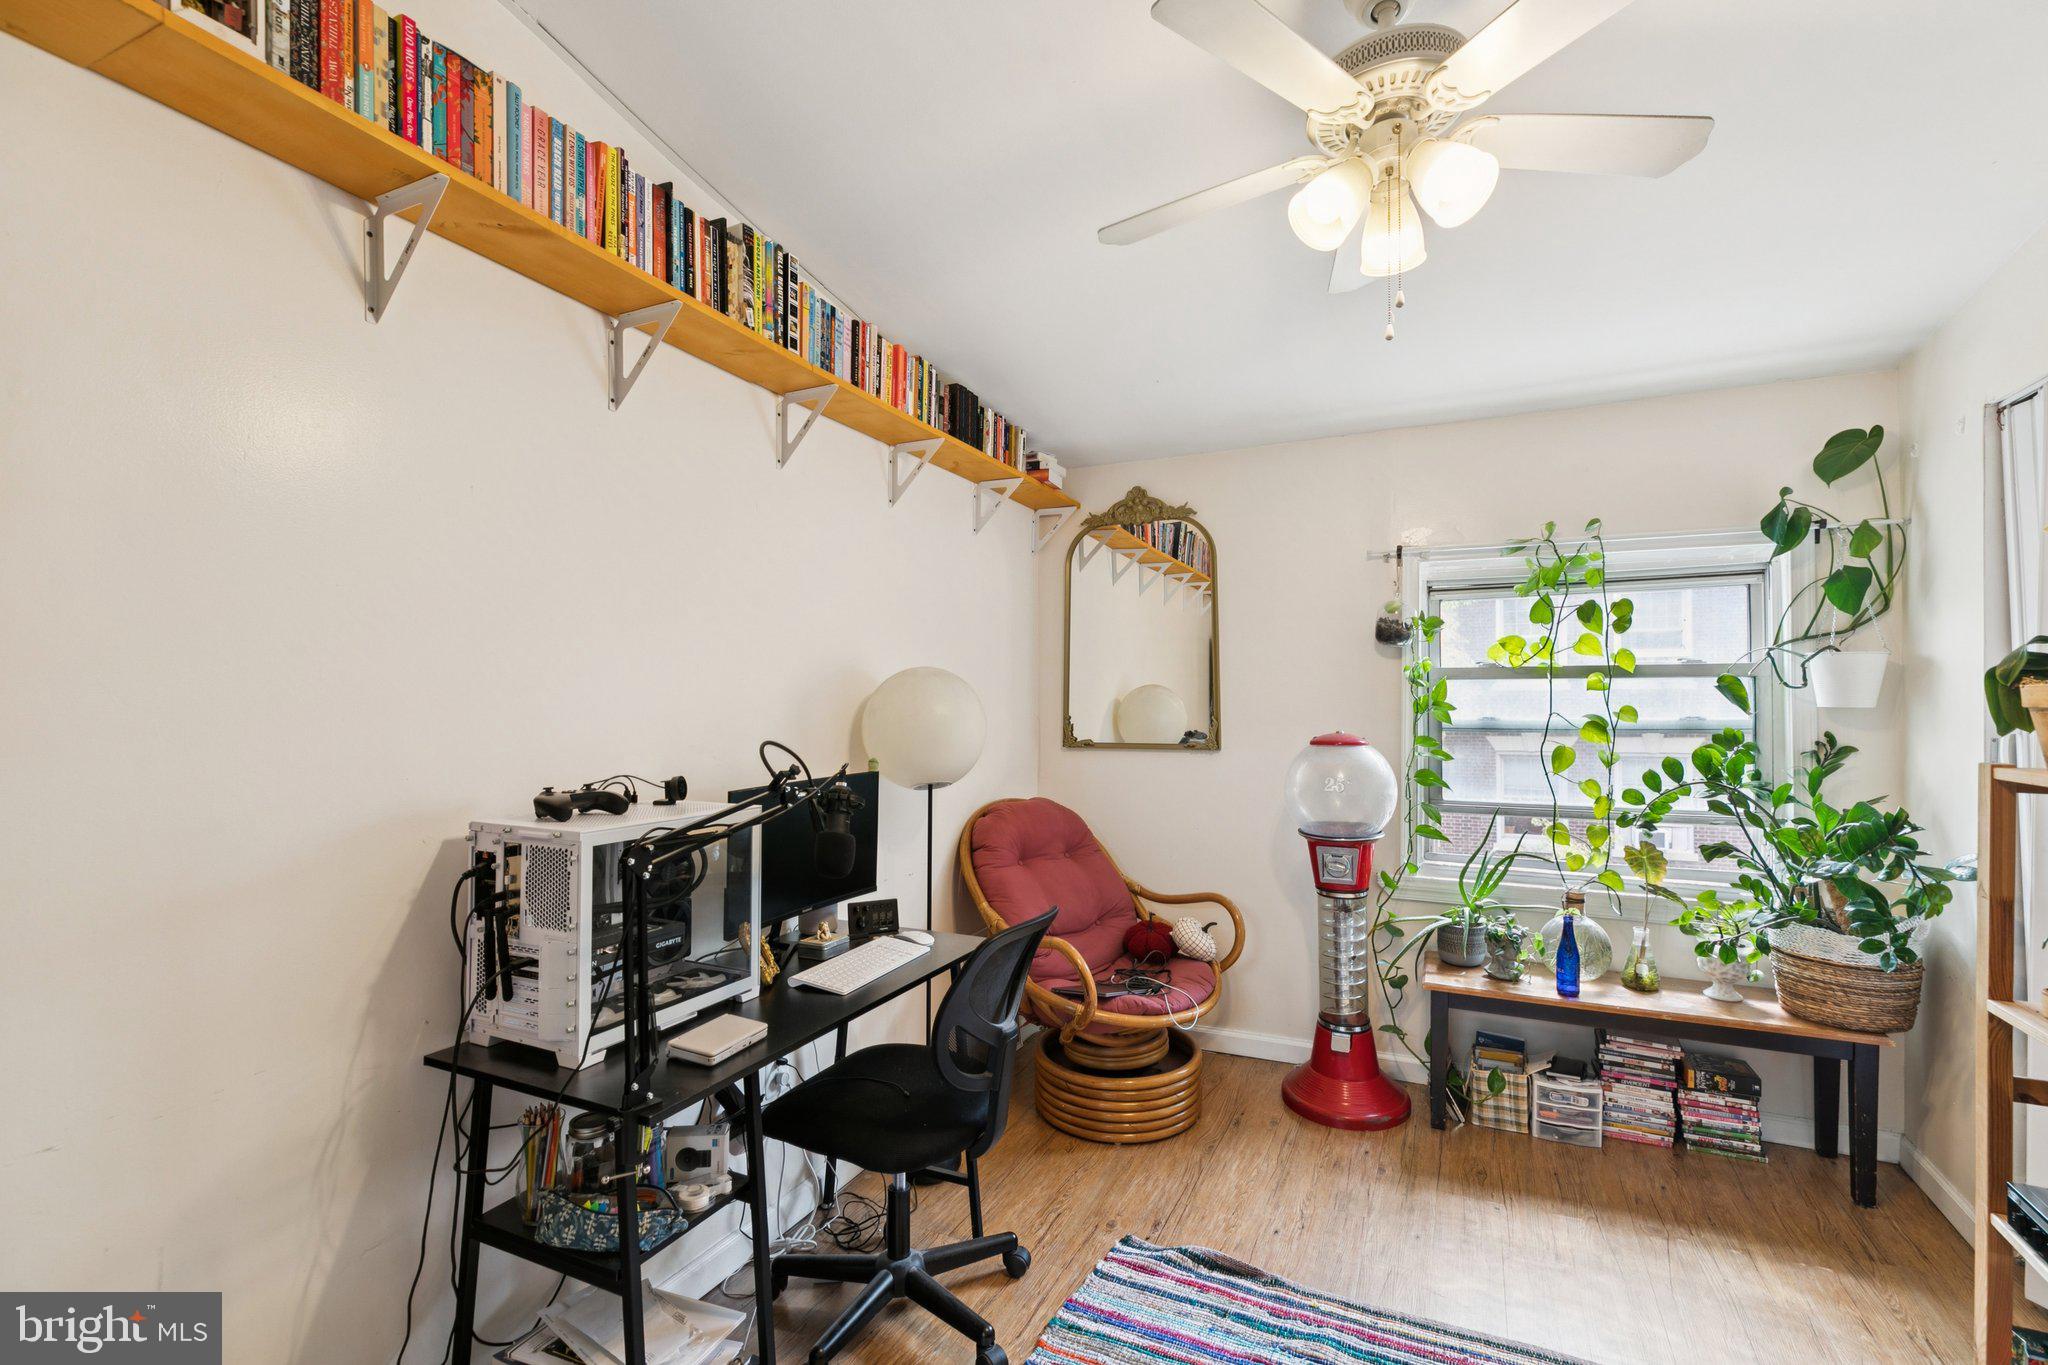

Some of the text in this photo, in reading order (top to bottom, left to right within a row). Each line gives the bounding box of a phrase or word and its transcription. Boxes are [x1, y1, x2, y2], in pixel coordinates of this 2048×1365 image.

[404, 19, 413, 47] JOJO
[328, 60, 338, 82] VOW
[404, 46, 414, 84] MOYES
[536, 127, 545, 162] GRACE
[537, 162, 545, 190] YEAR
[569, 176, 574, 188] US
[656, 936, 682, 948] GIGABYTE
